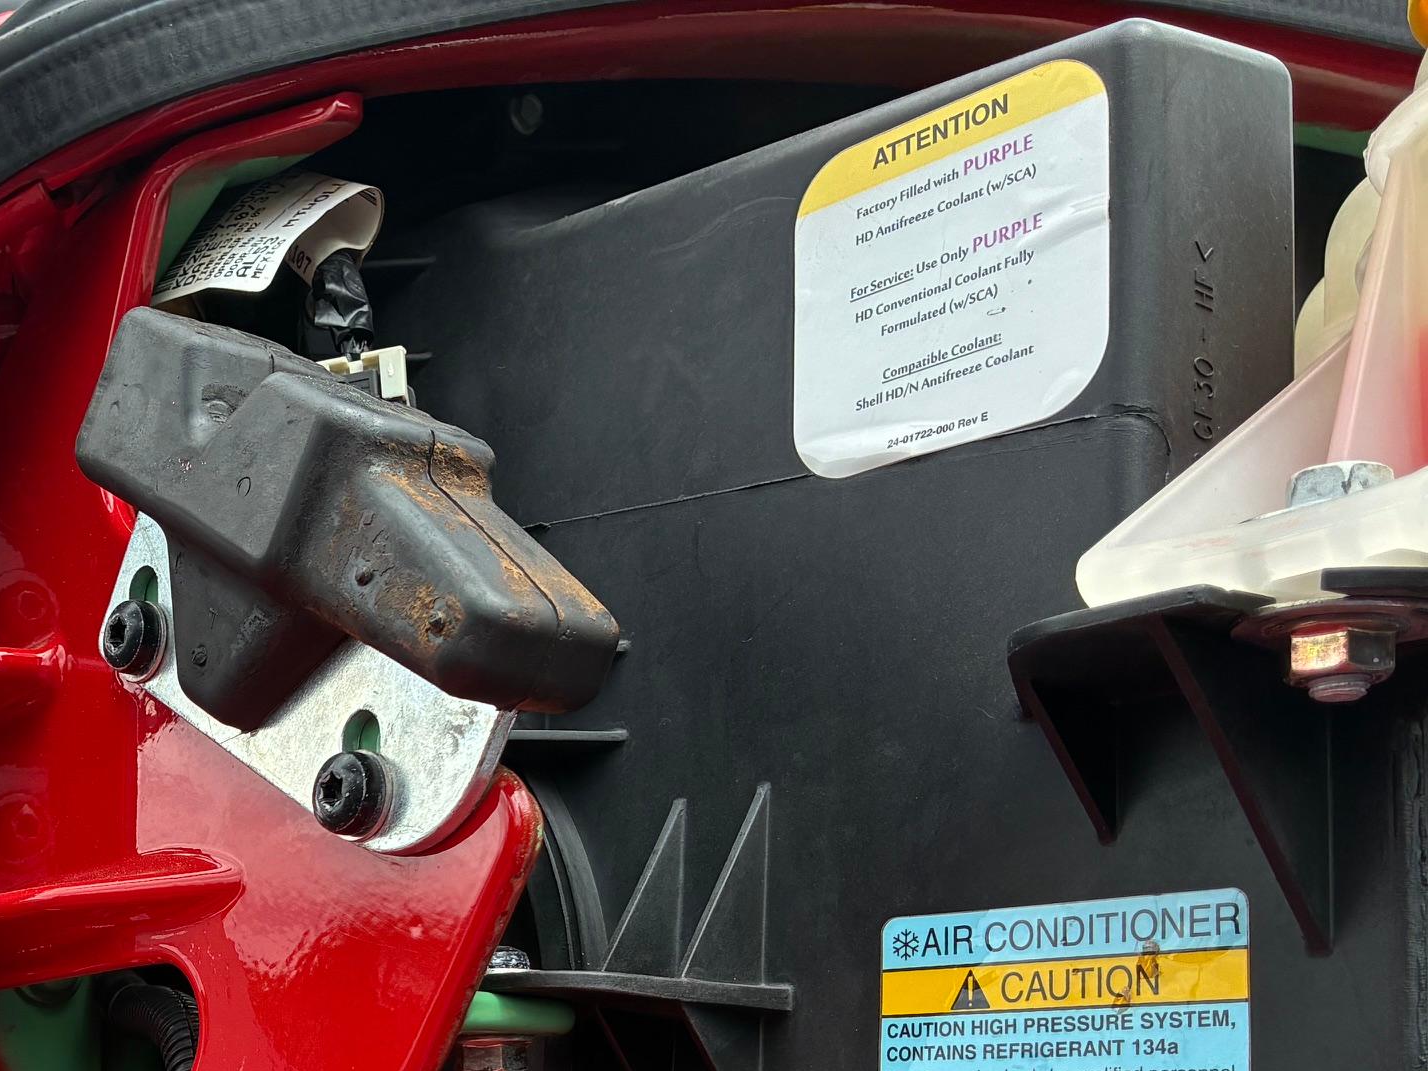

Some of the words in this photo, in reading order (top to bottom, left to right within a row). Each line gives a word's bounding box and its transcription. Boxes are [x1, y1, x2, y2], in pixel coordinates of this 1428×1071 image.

[873, 94, 1008, 169] ATTENTION
[857, 196, 897, 219] Factory
[900, 179, 931, 201] Filled
[933, 169, 959, 187] with
[963, 134, 1033, 175] PURPLE
[856, 231, 873, 245] HD
[876, 208, 934, 238] Antifreeze
[937, 187, 984, 213] Coolant
[986, 164, 1037, 196] (w/SCA)
[251, 239, 286, 279] MEXICO
[850, 286, 869, 299] For
[870, 269, 914, 292] Service:
[917, 260, 937, 274] Use
[940, 247, 969, 264] Only
[973, 212, 1043, 253] PURPLE
[855, 309, 873, 323] HD
[876, 278, 951, 315] Conventional
[955, 263, 1002, 286] Coolant
[1004, 250, 1034, 268] Fully
[881, 303, 946, 336] Formulated
[949, 284, 998, 314] (w/SCA)
[855, 393, 882, 411] Shell
[886, 381, 919, 401] HD/N
[922, 362, 982, 390] Antifreeze
[986, 345, 1034, 368] Coolant
[882, 349, 948, 381] Compatible
[952, 333, 1002, 356] Coolant:
[887, 422, 955, 448] 24-01722-000
[958, 417, 978, 429] Rev
[981, 412, 988, 421] E
[922, 925, 974, 957] AIR
[984, 902, 1241, 953] CONDITIONER
[1001, 964, 1159, 1003] CAUTION
[887, 1022, 965, 1039] CAUTION
[971, 1019, 1016, 1035] HIGH
[1023, 1014, 1134, 1034] PRESSURE
[1141, 1009, 1236, 1031] SYSTEM,
[887, 1044, 976, 1062] CONTAINS
[983, 1040, 1125, 1059] REFRIGERANT
[1132, 1038, 1179, 1056] 134a
